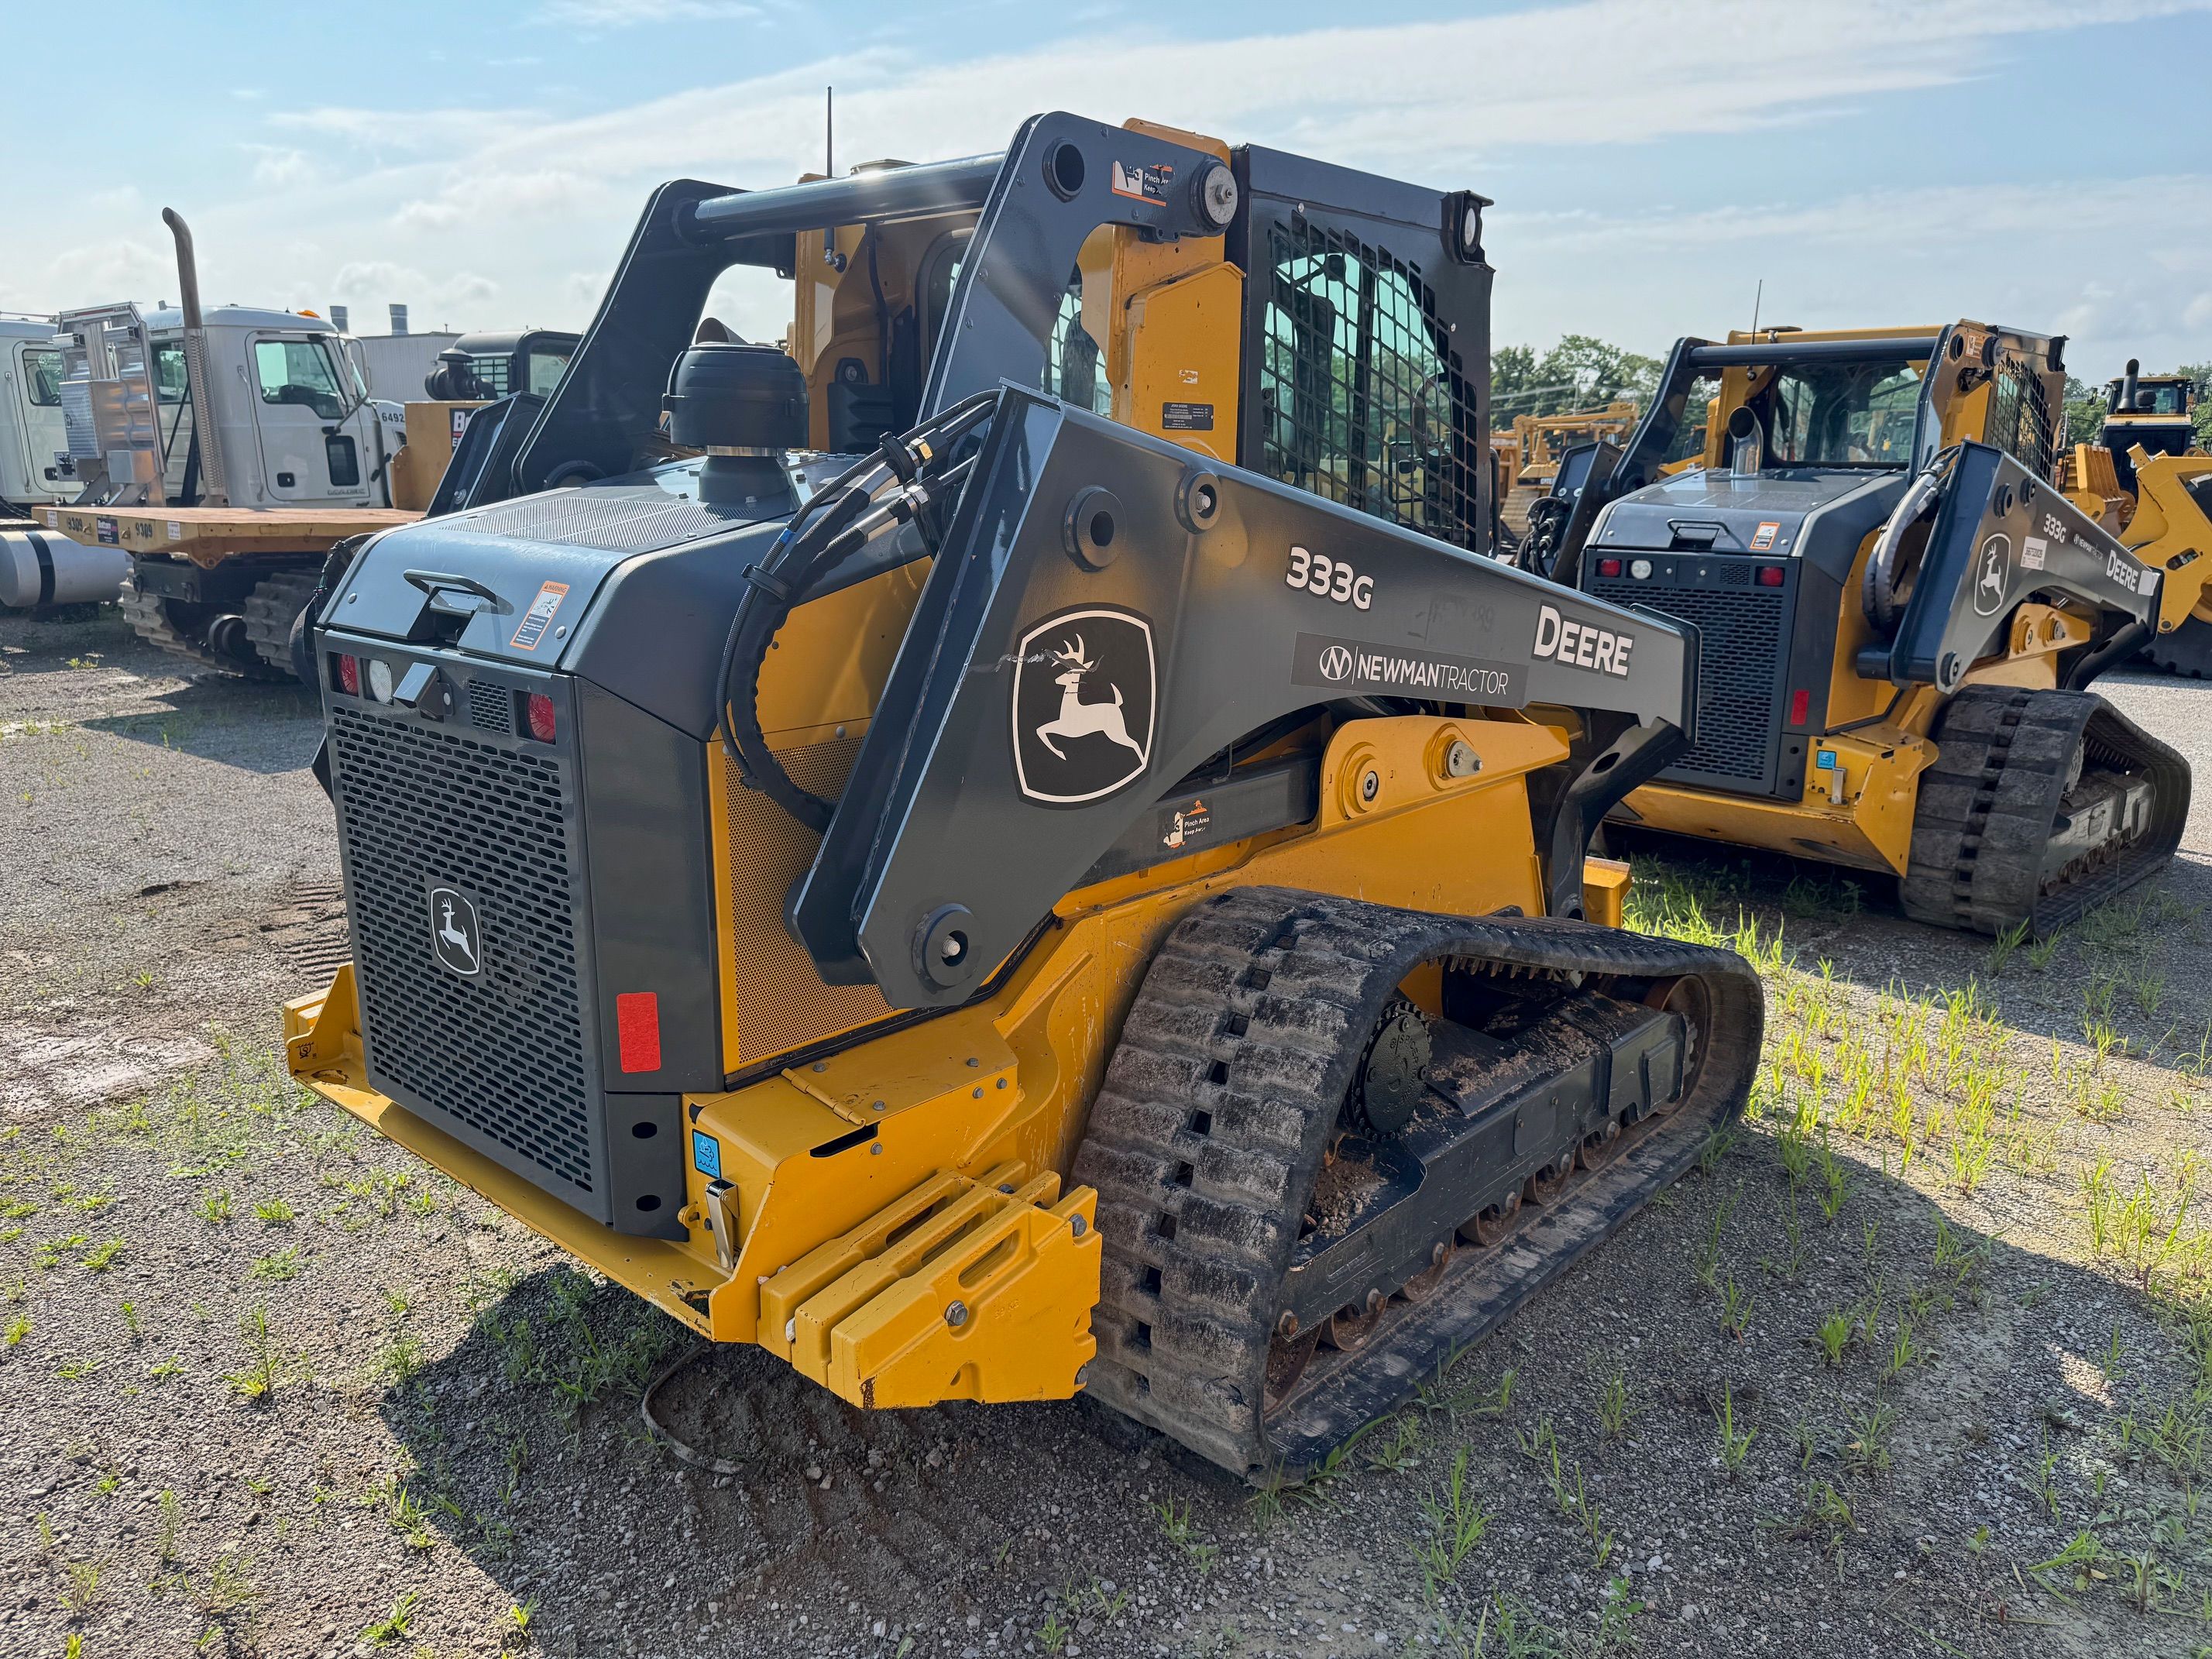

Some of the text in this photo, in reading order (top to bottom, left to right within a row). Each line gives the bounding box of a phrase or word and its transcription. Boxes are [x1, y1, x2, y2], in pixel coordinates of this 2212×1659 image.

[1144, 184, 1156, 194] Keep
[1145, 173, 1159, 184] Pinch
[382, 412, 405, 422] 6492
[136, 522, 153, 538] 9309
[2043, 514, 2066, 544] 333G
[1286, 546, 1374, 610] 333G
[2106, 549, 2139, 592] DEERE
[1534, 606, 1633, 676] DEERE
[1357, 654, 1509, 696] NEWMANTRACTOR
[1184, 819, 1198, 828] Pinch
